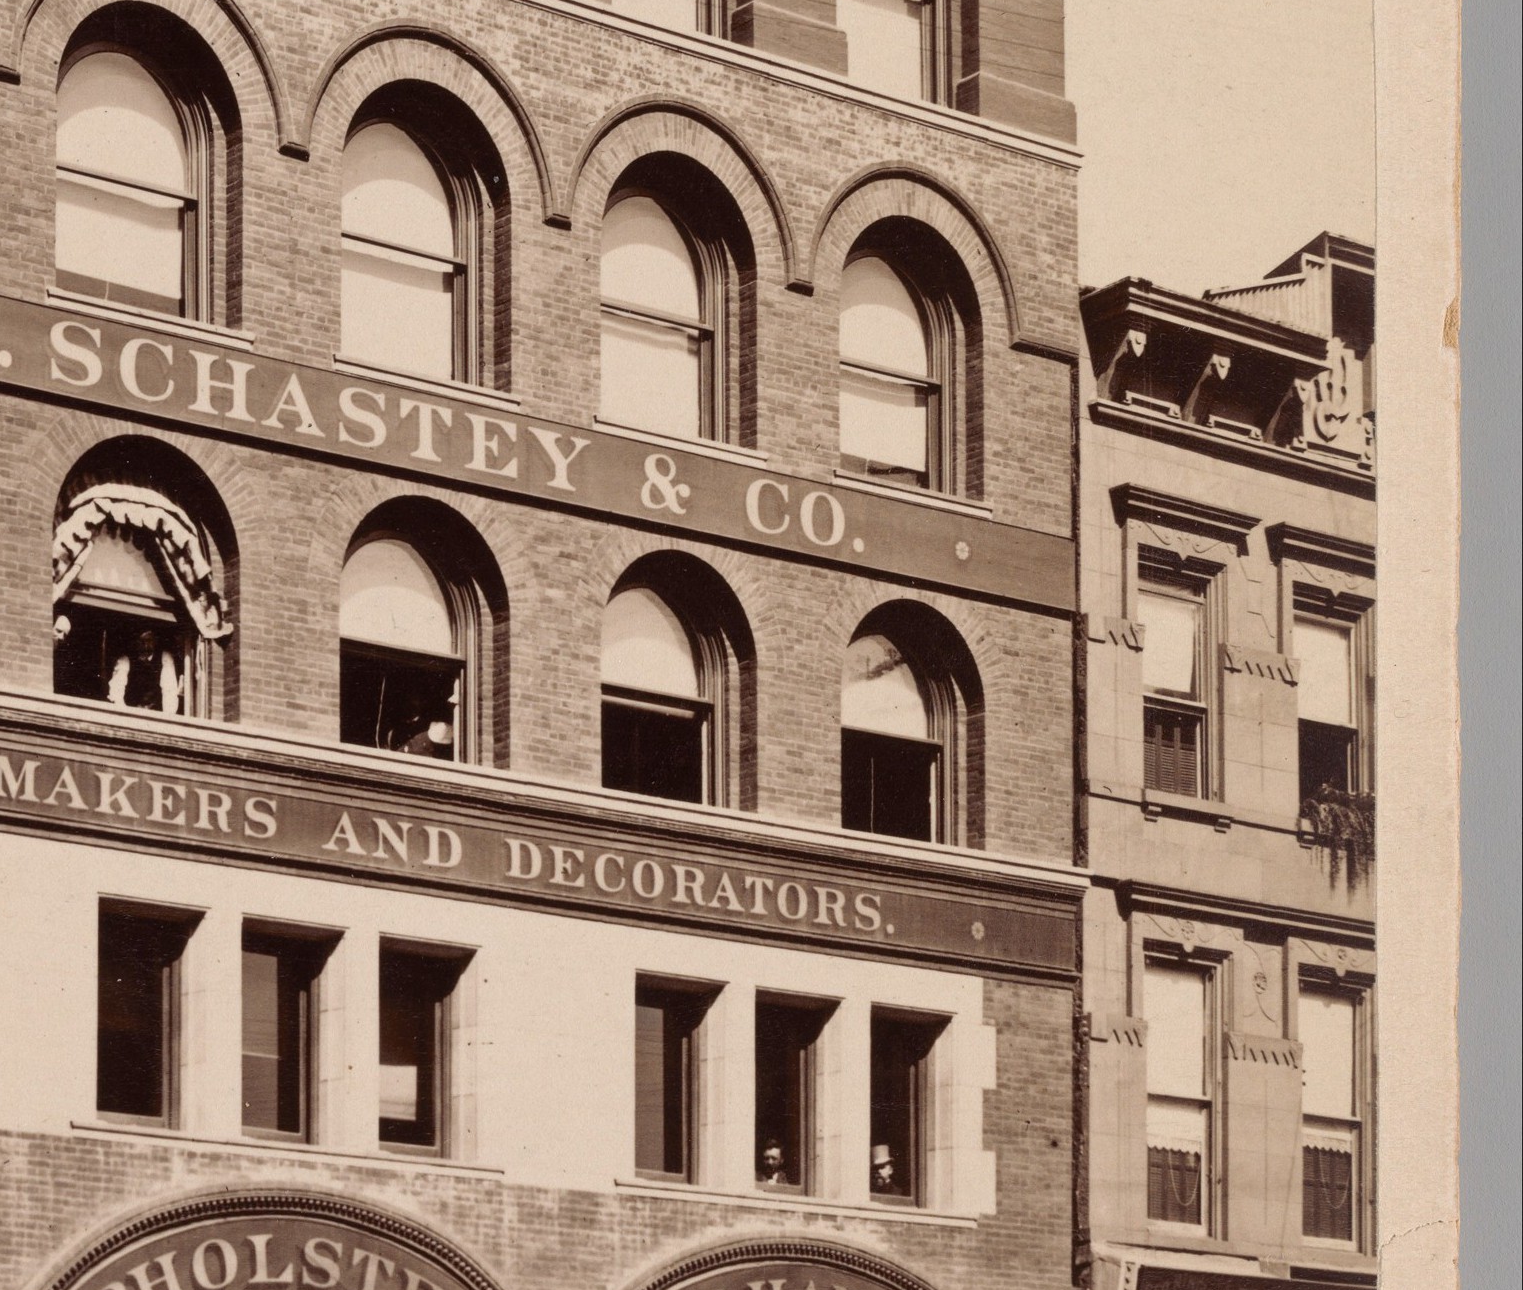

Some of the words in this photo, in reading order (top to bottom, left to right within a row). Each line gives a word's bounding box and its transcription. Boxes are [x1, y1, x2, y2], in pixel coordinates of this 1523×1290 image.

[49, 320, 593, 492] SCHASTEY
[640, 453, 691, 515] &
[745, 478, 866, 554] CO.
[321, 810, 463, 869] AND
[504, 837, 896, 936] DECORATORS.
